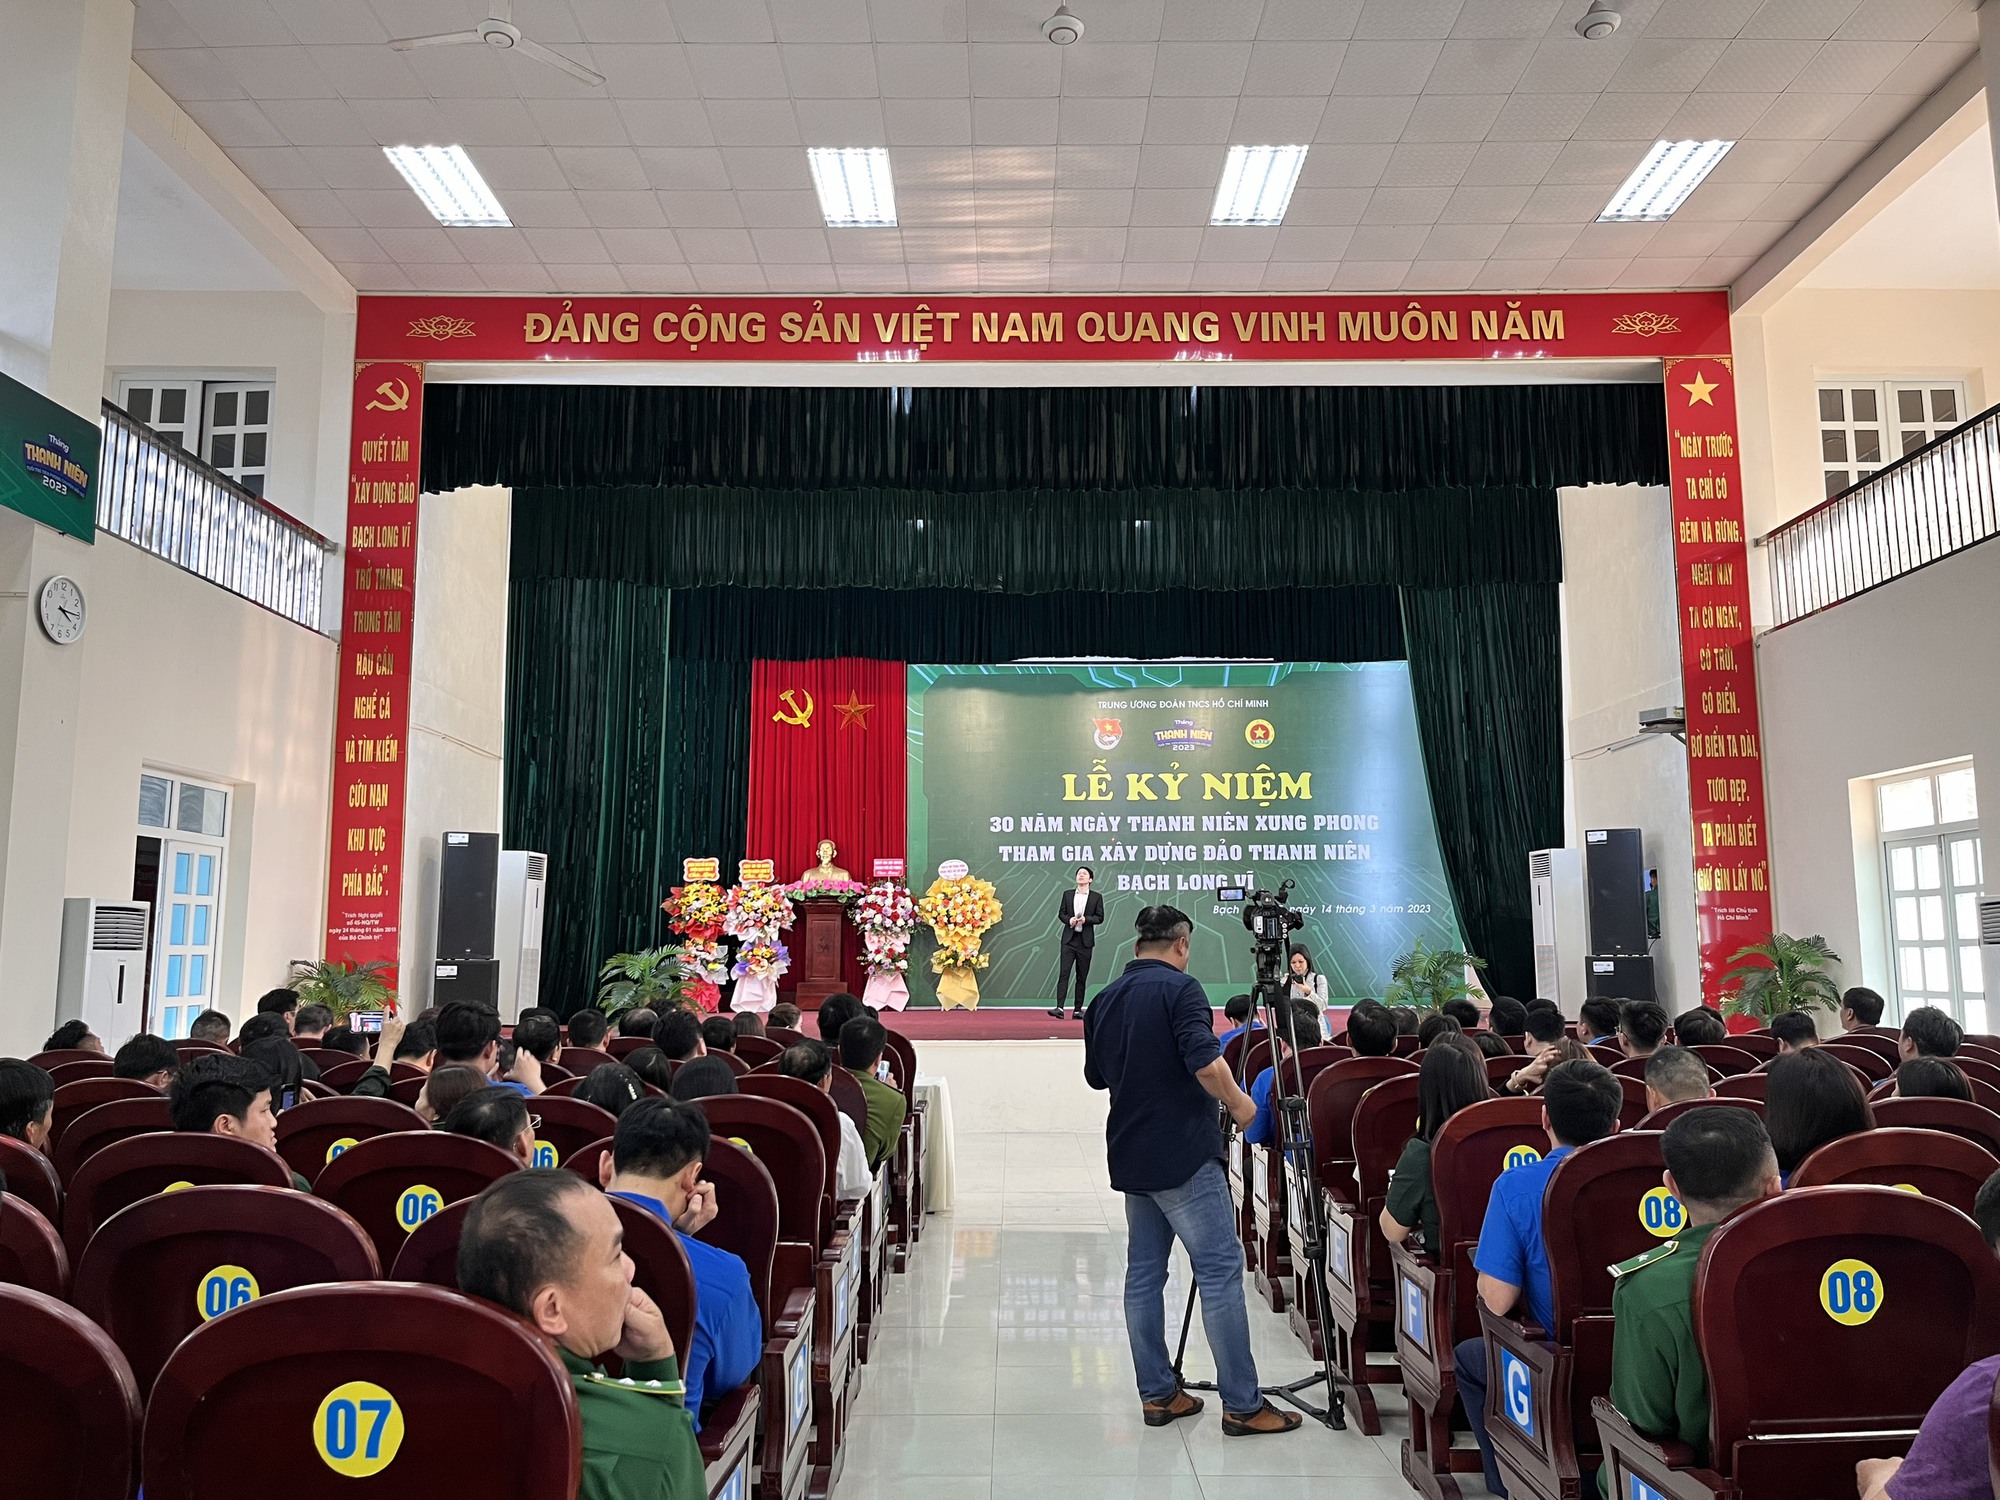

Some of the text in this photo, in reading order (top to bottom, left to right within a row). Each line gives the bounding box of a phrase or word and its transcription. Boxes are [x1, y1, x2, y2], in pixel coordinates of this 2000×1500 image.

[524, 299, 1566, 351] ĐẢNG CỘNG SẢN VIỆT NAM QUANG VINH MUÔN NĂM
[48, 434, 70, 454] Tháng
[362, 433, 409, 464] QUYẾT TÂM
[1706, 431, 1733, 458] TRƯỚC
[25, 443, 62, 472] THANH
[64, 460, 88, 488] NIÊN
[42, 476, 68, 496] 2023
[372, 480, 396, 508] DỰNG
[398, 474, 414, 504] BẢO
[1686, 469, 1728, 500] TA CHỈ CÓ
[352, 522, 411, 552] BẠCH LONG VĨ
[1680, 516, 1698, 544] ĐÊM
[1702, 516, 1712, 543] VÀ
[356, 560, 403, 590] TRỞ THÀNH
[1692, 559, 1732, 586] NGÀY NAY
[354, 606, 401, 632] TRUNG TÂM
[1689, 606, 1700, 628] TA
[1702, 600, 1714, 628] CÓ
[356, 648, 374, 680] HẬU
[1700, 643, 1712, 671] CÓ
[354, 688, 390, 719] NGHỀ CÁ
[1098, 700, 1128, 709] TRUNG
[1130, 700, 1157, 709] ƯƠNG
[1160, 698, 1186, 708] ĐOÀN
[1188, 700, 1210, 708] TNCS
[1212, 698, 1224, 708] HỒ
[1227, 698, 1243, 708] CHÍ
[1702, 686, 1714, 714] CÓ
[346, 734, 398, 762] VÀ TÌM KIẾM
[1155, 728, 1213, 740] THANH NIÊN
[1691, 728, 1702, 758] BỜ
[1705, 725, 1725, 758] BIỂN
[1727, 734, 1738, 757] TA
[349, 779, 388, 811] CỨU NẠN
[1062, 758, 1312, 807] LỄ KỶ NIỆM
[1707, 777, 1728, 802] TƯƠI
[990, 811, 1379, 832] 30 NĂM NGÀY THANH NIÊN XUNG PHONG
[1702, 814, 1757, 846] TA PHẢI BIẾT
[347, 826, 386, 856] KHU VỰC
[999, 839, 1371, 865] THAM GIA XÂY DỰNG ĐẢO THANH NIÊN
[342, 868, 362, 896] PHÍA
[1118, 871, 1254, 895] BẠCH LONG VĨ
[1697, 863, 1713, 892] GIỮ
[1714, 863, 1730, 892] GÌN
[1733, 861, 1748, 891] LẤY
[1213, 905, 1239, 916] Bạch
[1321, 904, 1332, 914] 14
[1336, 904, 1366, 915] tháng
[1370, 905, 1376, 914] 3
[1380, 904, 1403, 914] năm
[1407, 904, 1431, 914] 2023
[402, 1193, 438, 1225] 06
[1645, 1195, 1682, 1229] 08
[205, 1276, 251, 1318] 06
[1828, 1270, 1876, 1314] 08
[1407, 1284, 1417, 1333] F
[1508, 1359, 1530, 1426] G
[325, 1398, 392, 1459] 07
